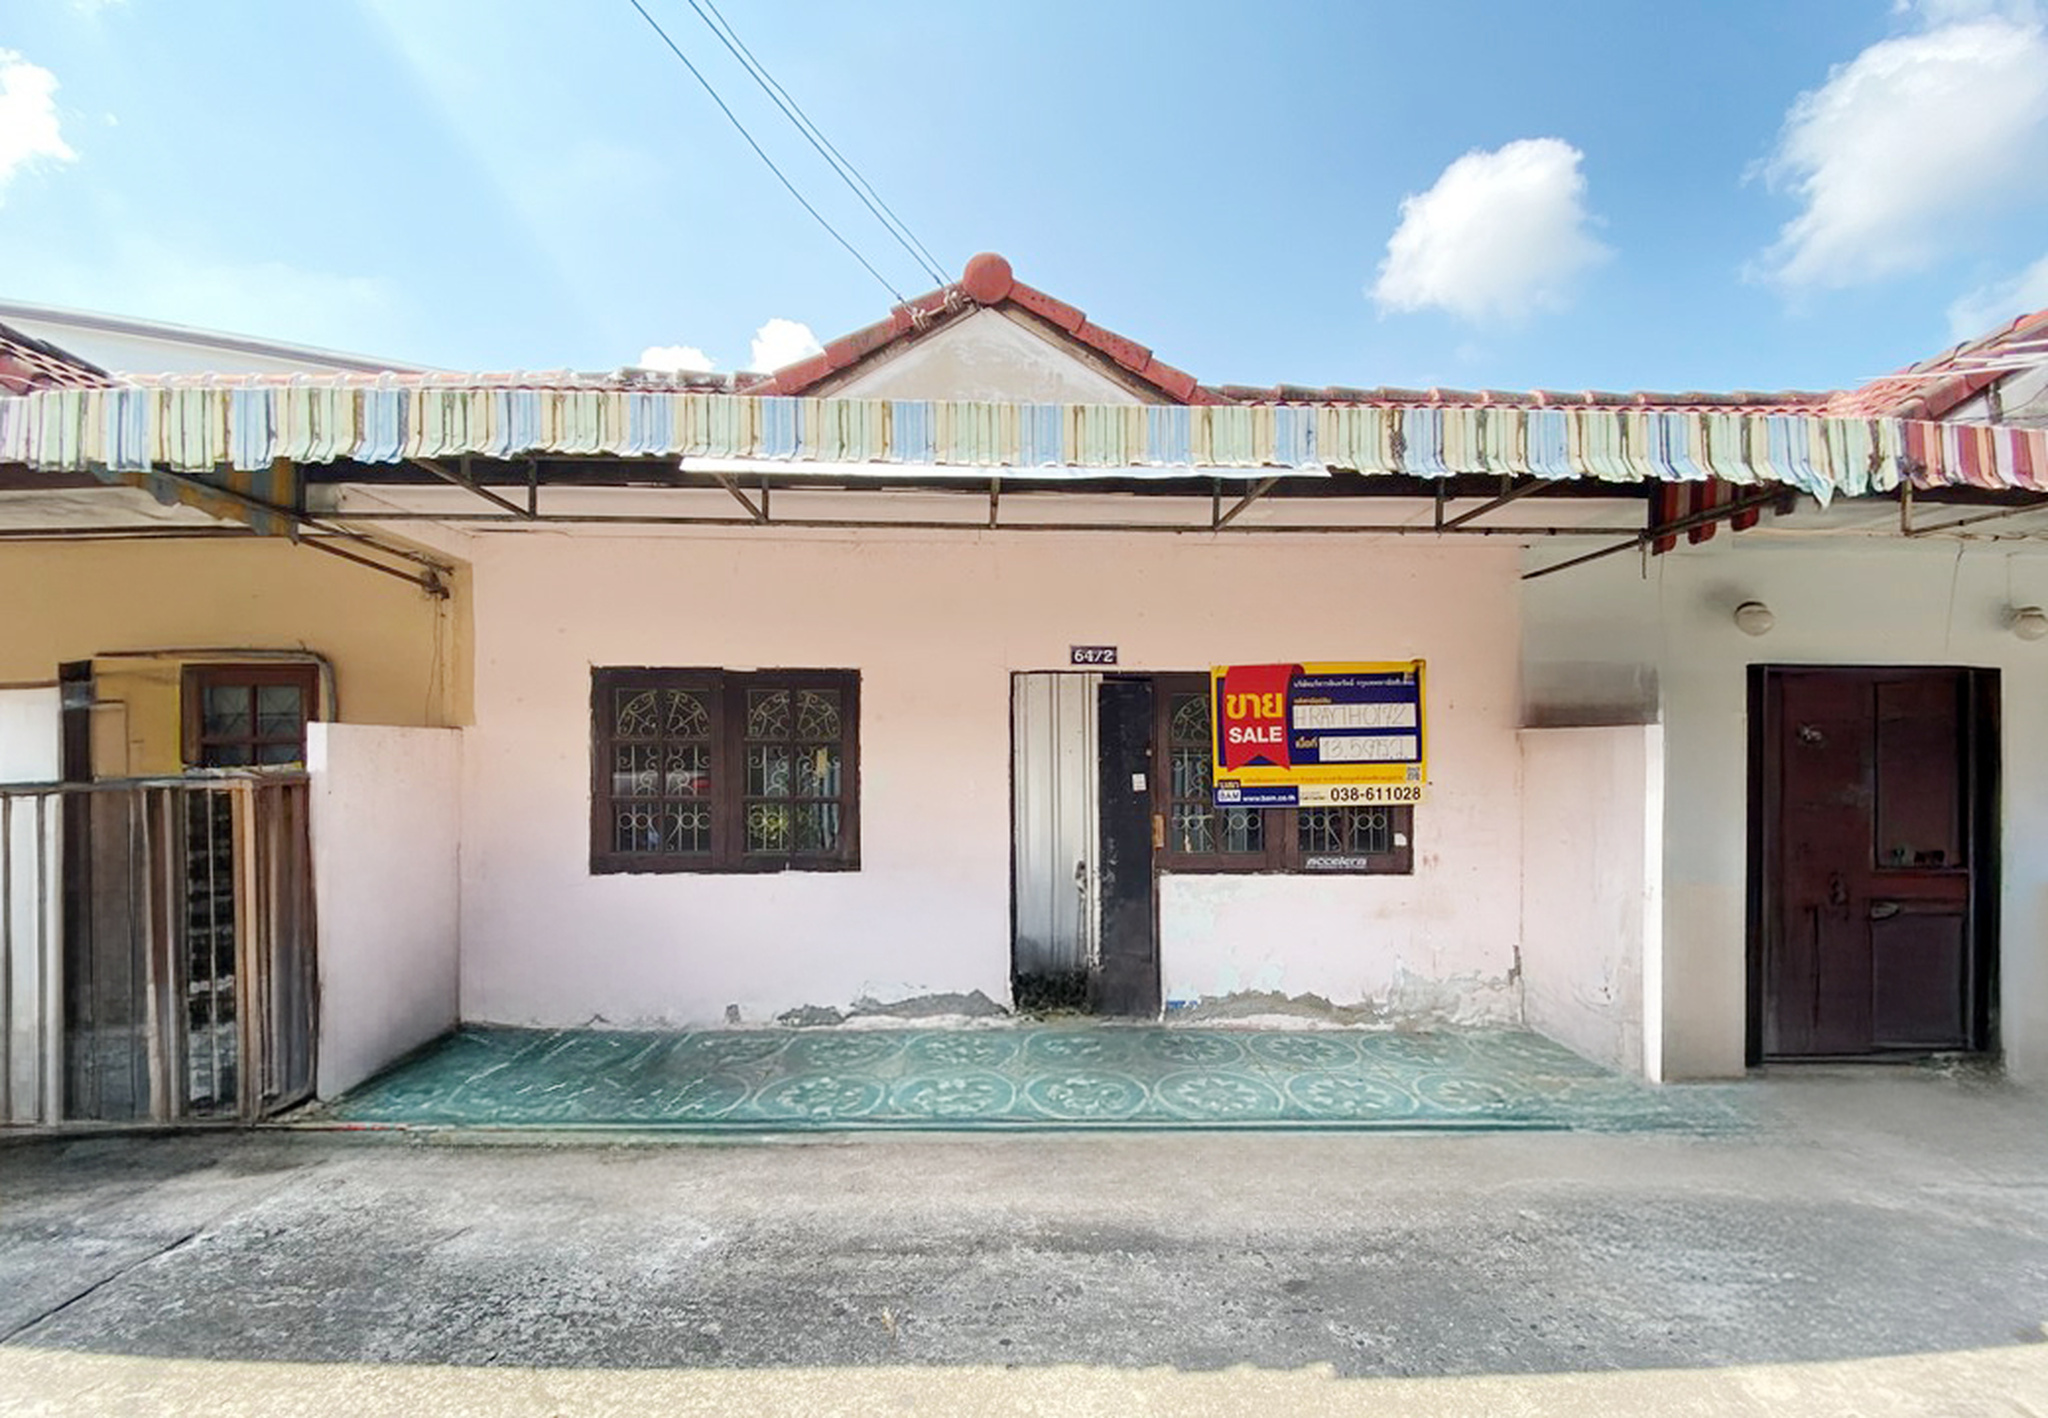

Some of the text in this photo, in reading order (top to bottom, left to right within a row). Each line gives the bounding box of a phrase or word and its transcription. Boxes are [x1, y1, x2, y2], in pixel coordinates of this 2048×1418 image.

[1226, 693, 1282, 719] ขาย
[1229, 726, 1283, 743] SALE
[1330, 786, 1421, 802] 038-611028
